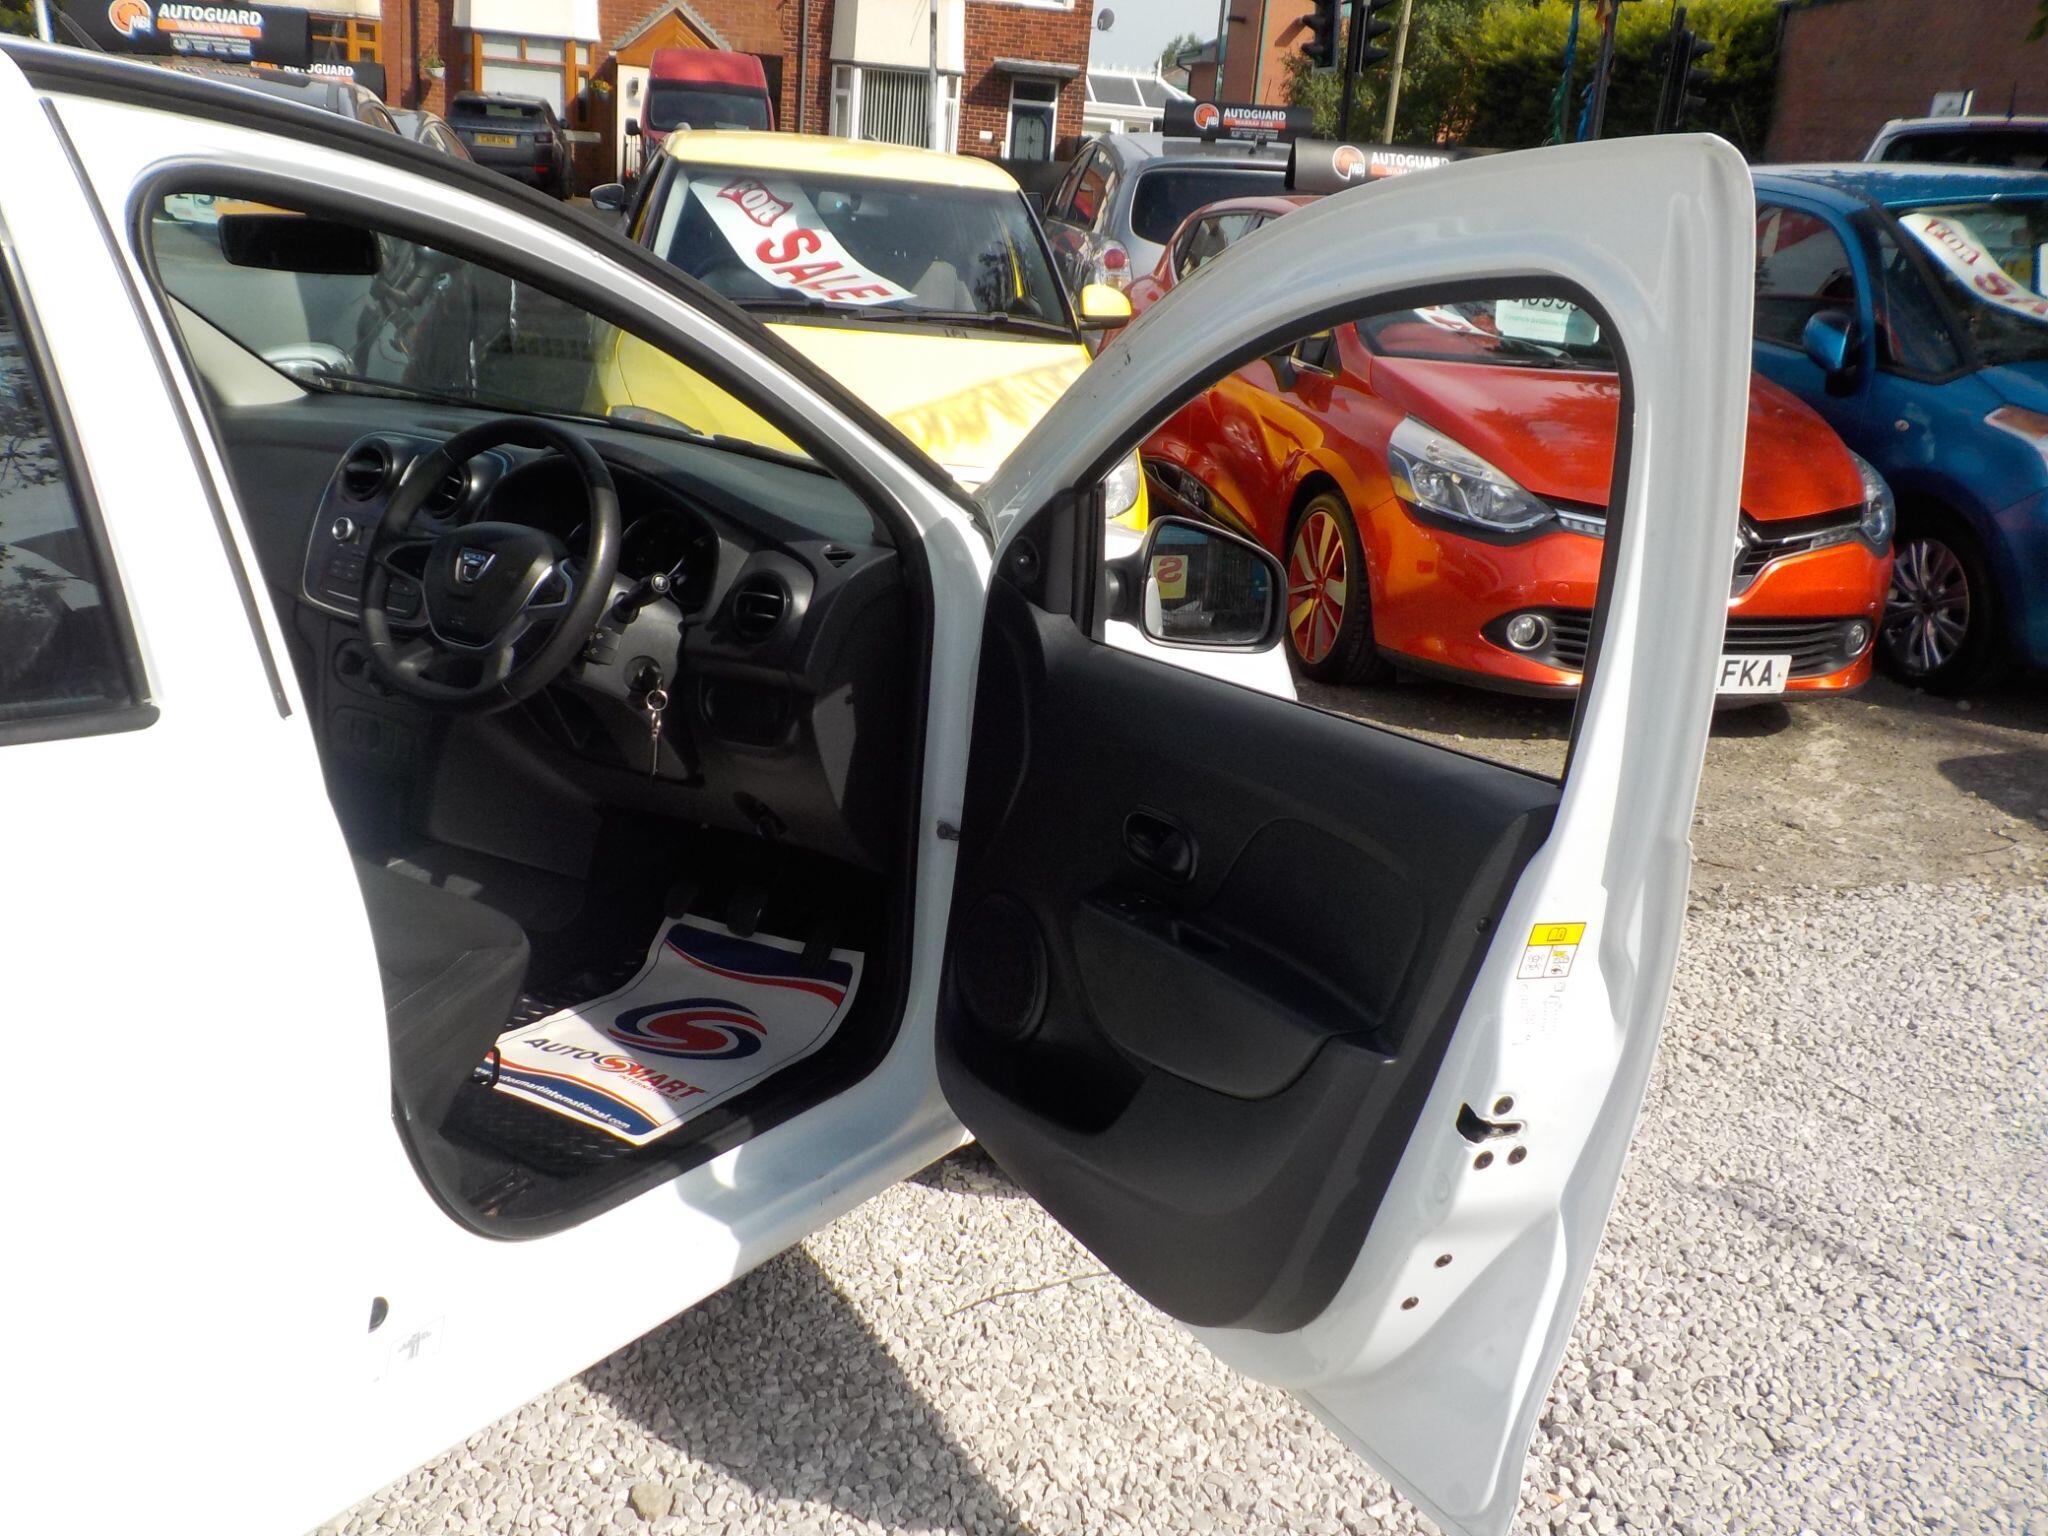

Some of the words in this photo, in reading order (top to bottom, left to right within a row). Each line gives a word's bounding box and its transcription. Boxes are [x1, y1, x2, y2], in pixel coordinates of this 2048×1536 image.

[158, 3, 262, 26] AUTOGUARD
[1223, 107, 1287, 121] AUTOGUARD
[717, 176, 794, 227] FOR
[756, 228, 893, 300] SALE
[1720, 660, 1773, 686] FKA
